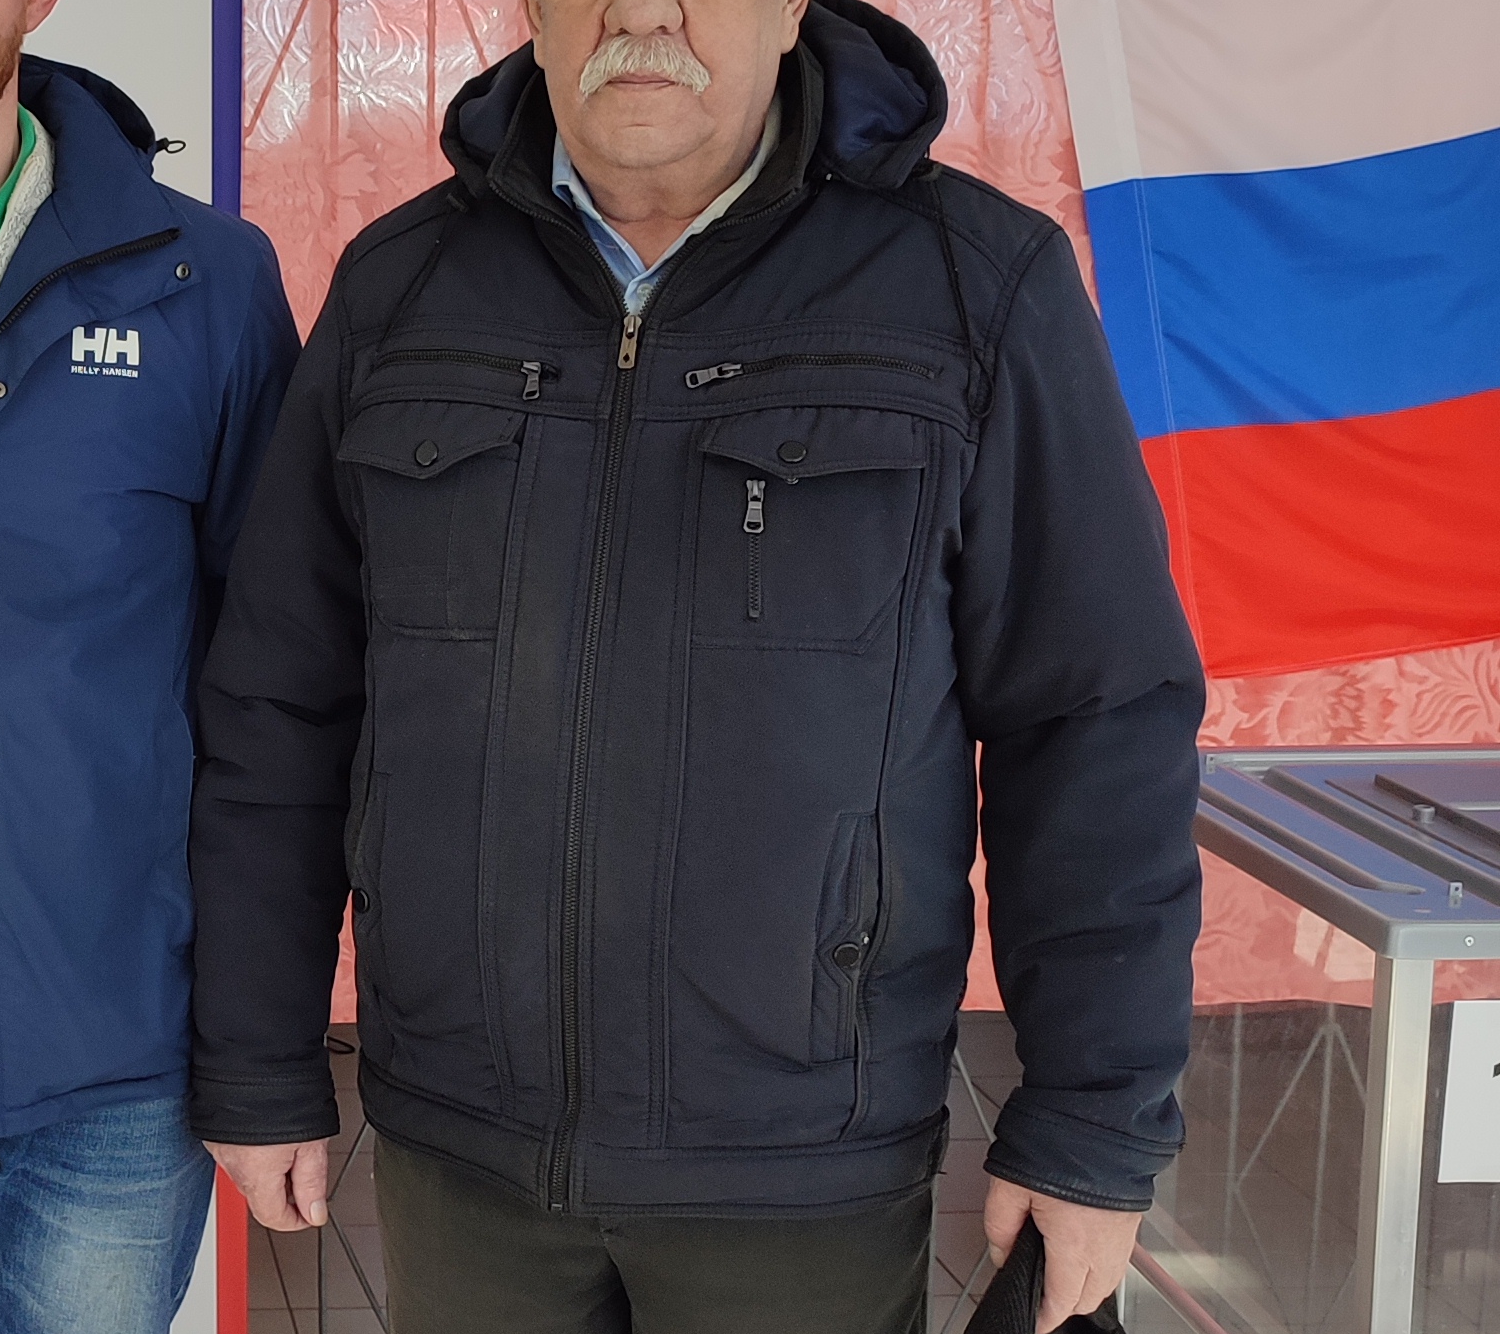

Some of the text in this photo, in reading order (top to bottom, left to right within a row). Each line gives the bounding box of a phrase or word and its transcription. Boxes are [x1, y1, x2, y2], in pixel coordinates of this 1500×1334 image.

[72, 326, 139, 366] HH
[71, 365, 139, 378] HELLY HANSEN
